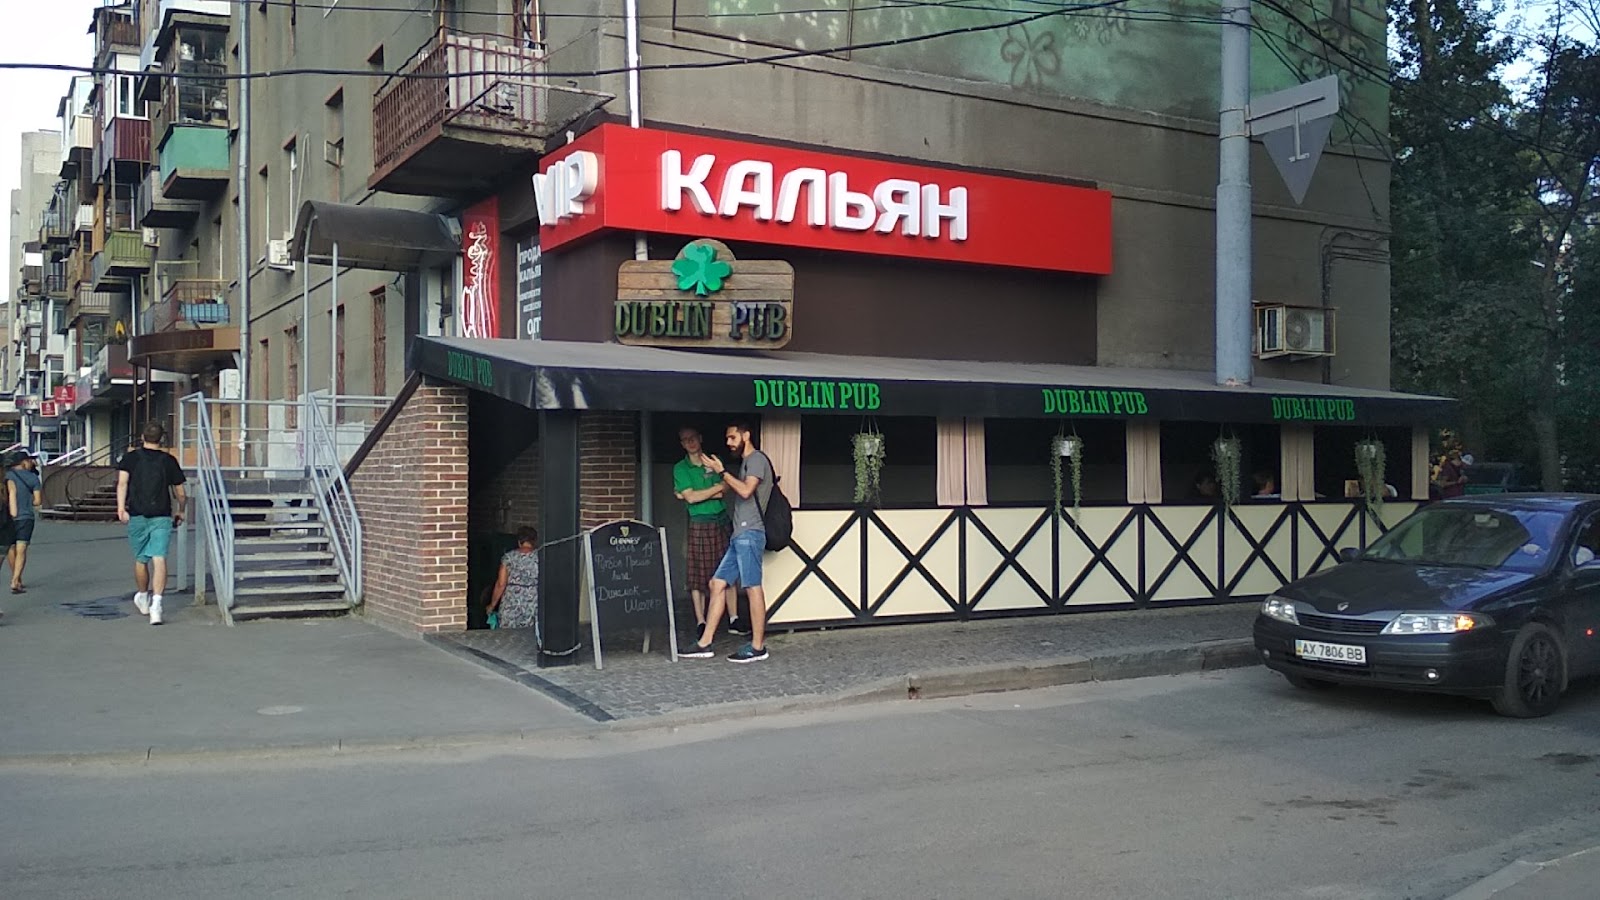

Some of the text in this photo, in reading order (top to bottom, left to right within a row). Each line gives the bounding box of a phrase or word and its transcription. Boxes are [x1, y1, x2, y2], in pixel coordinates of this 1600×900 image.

[532, 150, 599, 226] VIP
[661, 149, 968, 242] КАЛЬЯН
[614, 300, 788, 340] DUBLIN PUB
[447, 351, 473, 382] DUBLIN
[753, 379, 881, 410] DUBLIN PUB
[1042, 389, 1148, 414] DUBLIN PUB
[1271, 397, 1355, 420] DUBLIN PUB
[1303, 643, 1363, 660] AX 7806 BB
